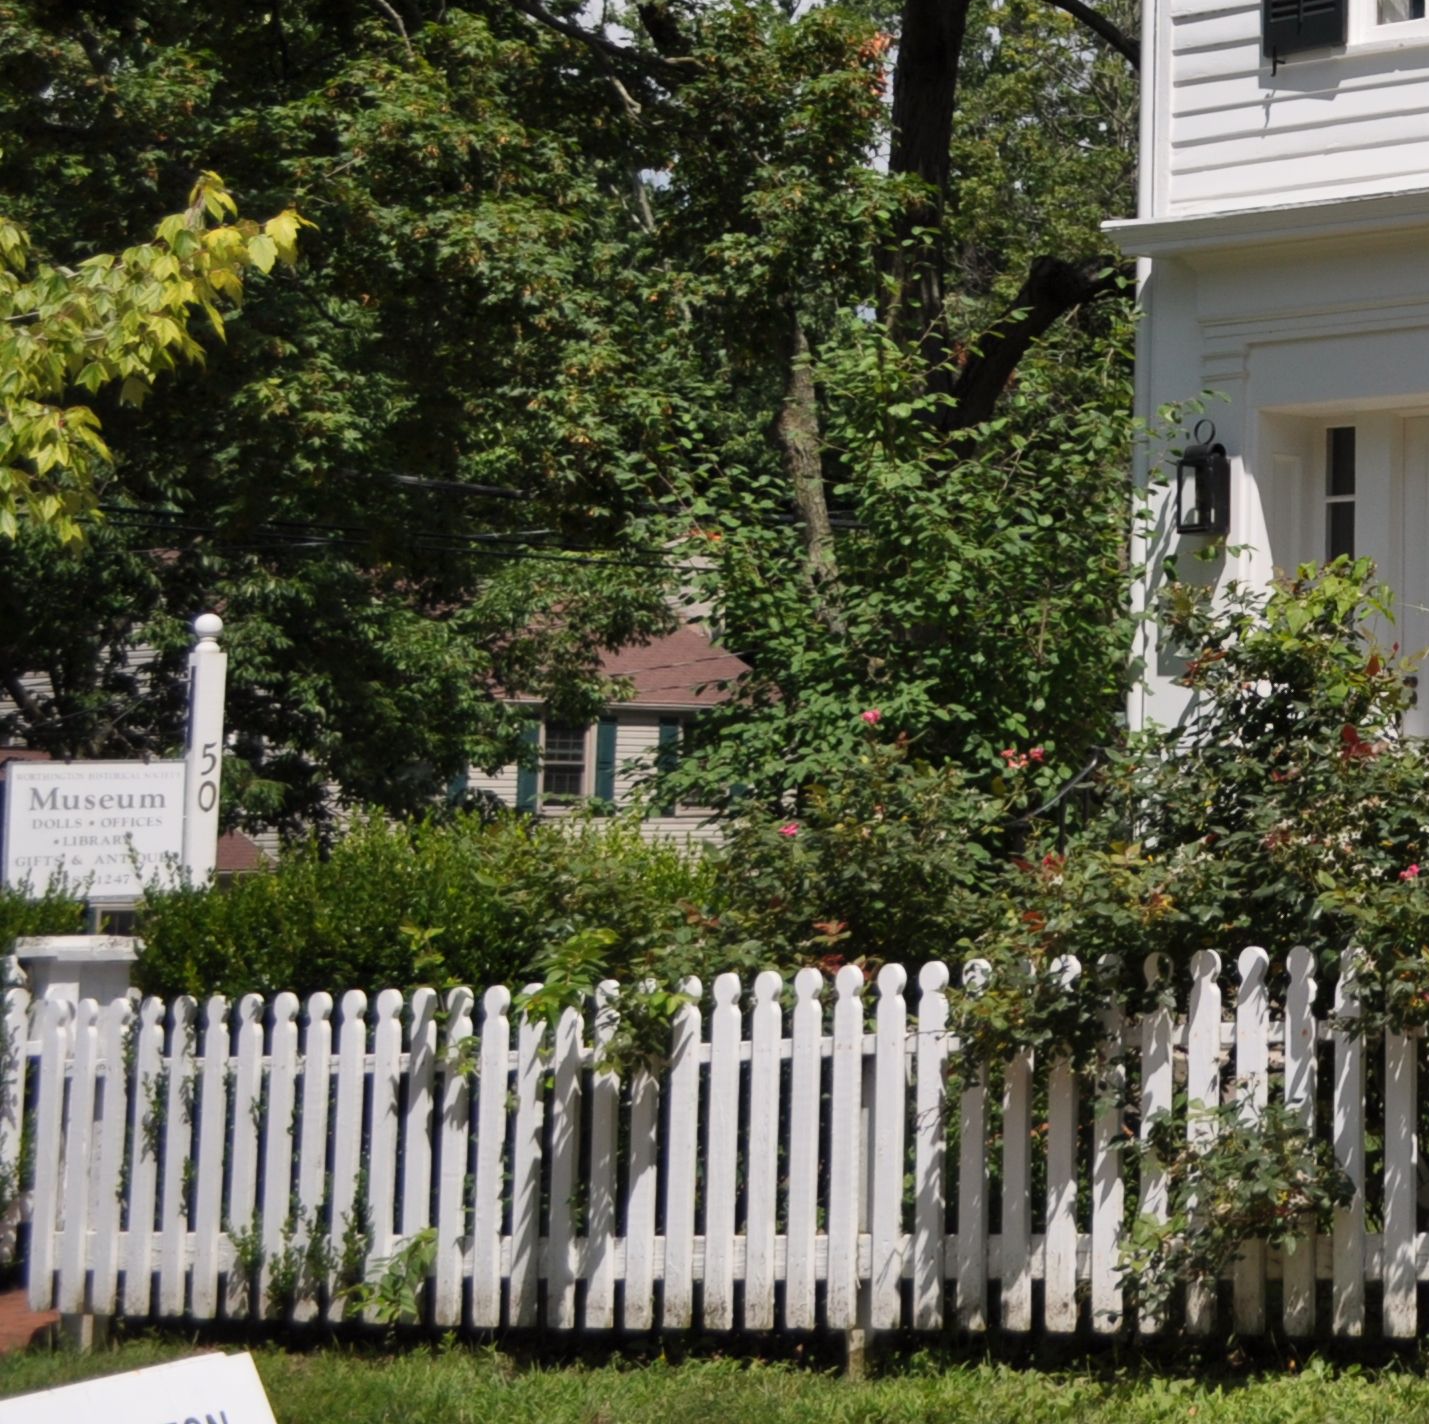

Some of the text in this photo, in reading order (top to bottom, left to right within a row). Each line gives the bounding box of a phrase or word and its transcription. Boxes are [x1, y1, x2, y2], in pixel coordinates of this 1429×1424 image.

[198, 742, 217, 813] 50
[29, 787, 166, 811] Museum
[32, 816, 163, 830] DOLLS OFFICES
[15, 854, 63, 867] GIFTS
[72, 854, 83, 866] &
